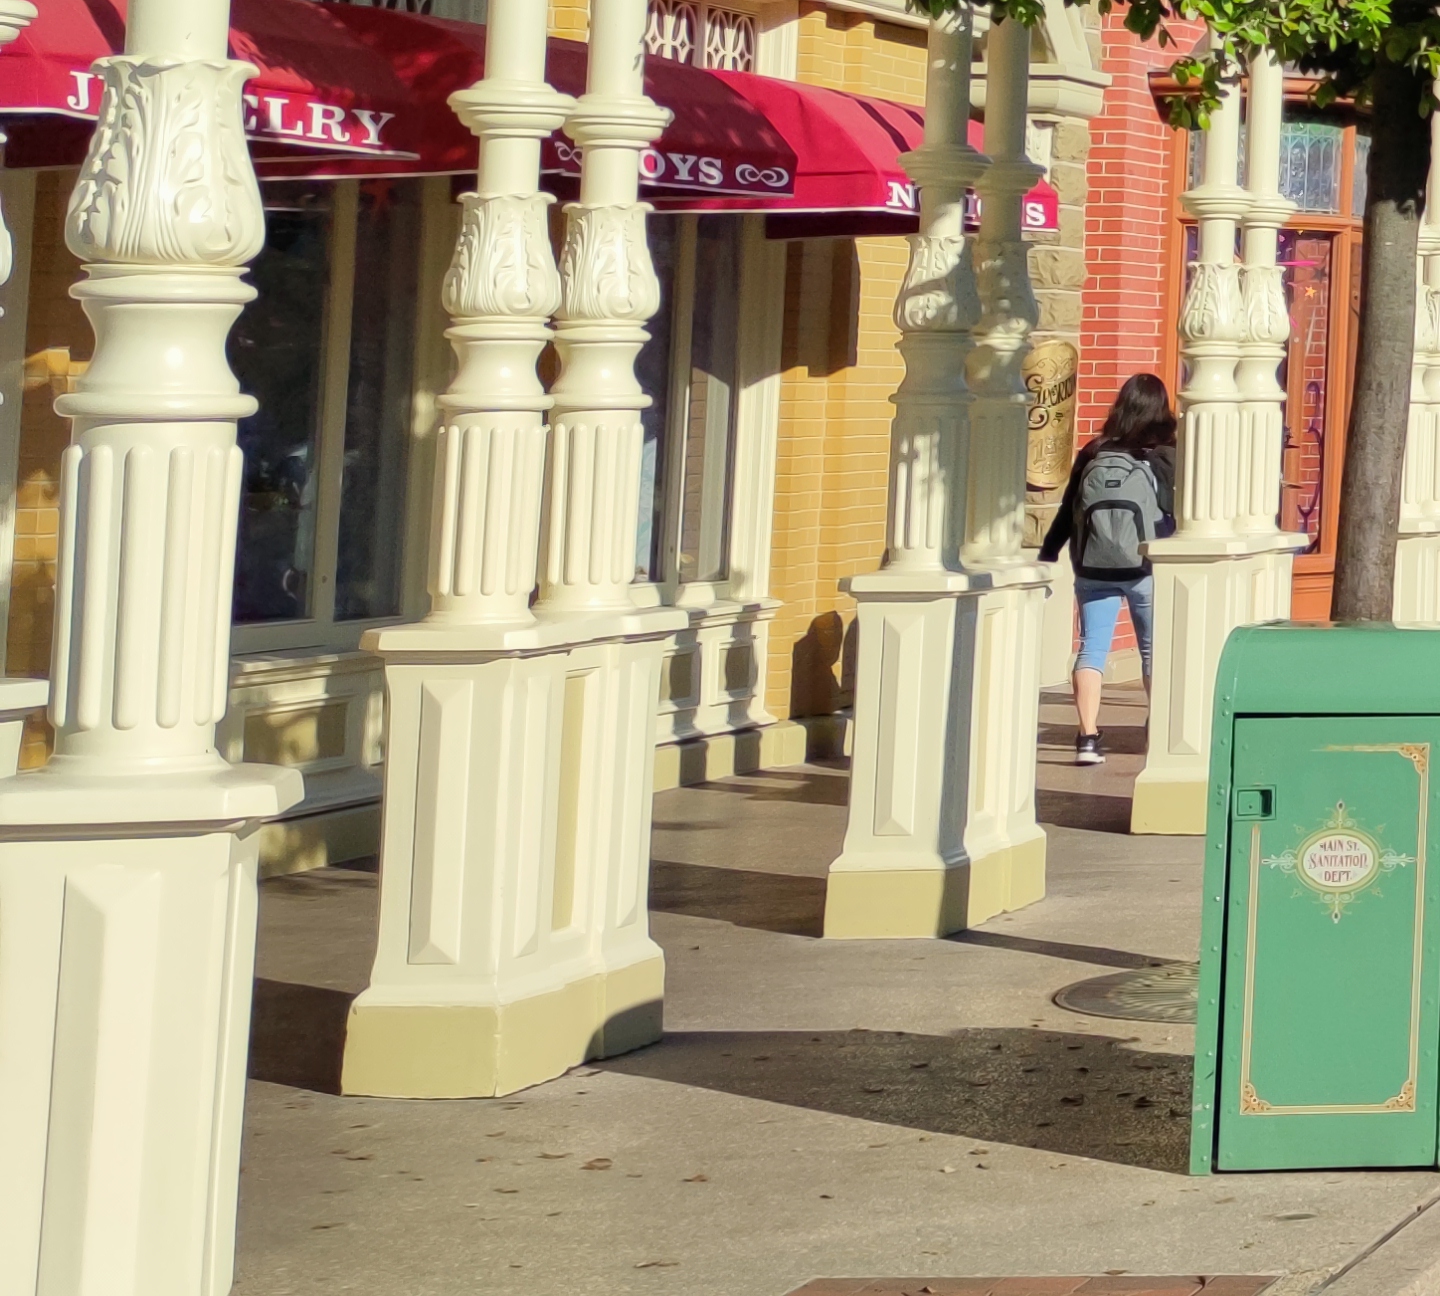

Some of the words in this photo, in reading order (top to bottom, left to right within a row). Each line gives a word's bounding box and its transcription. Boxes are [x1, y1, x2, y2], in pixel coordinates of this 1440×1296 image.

[638, 148, 724, 186] OYS
[1320, 839, 1344, 852] MAIN
[1308, 852, 1369, 869] SANITATION
